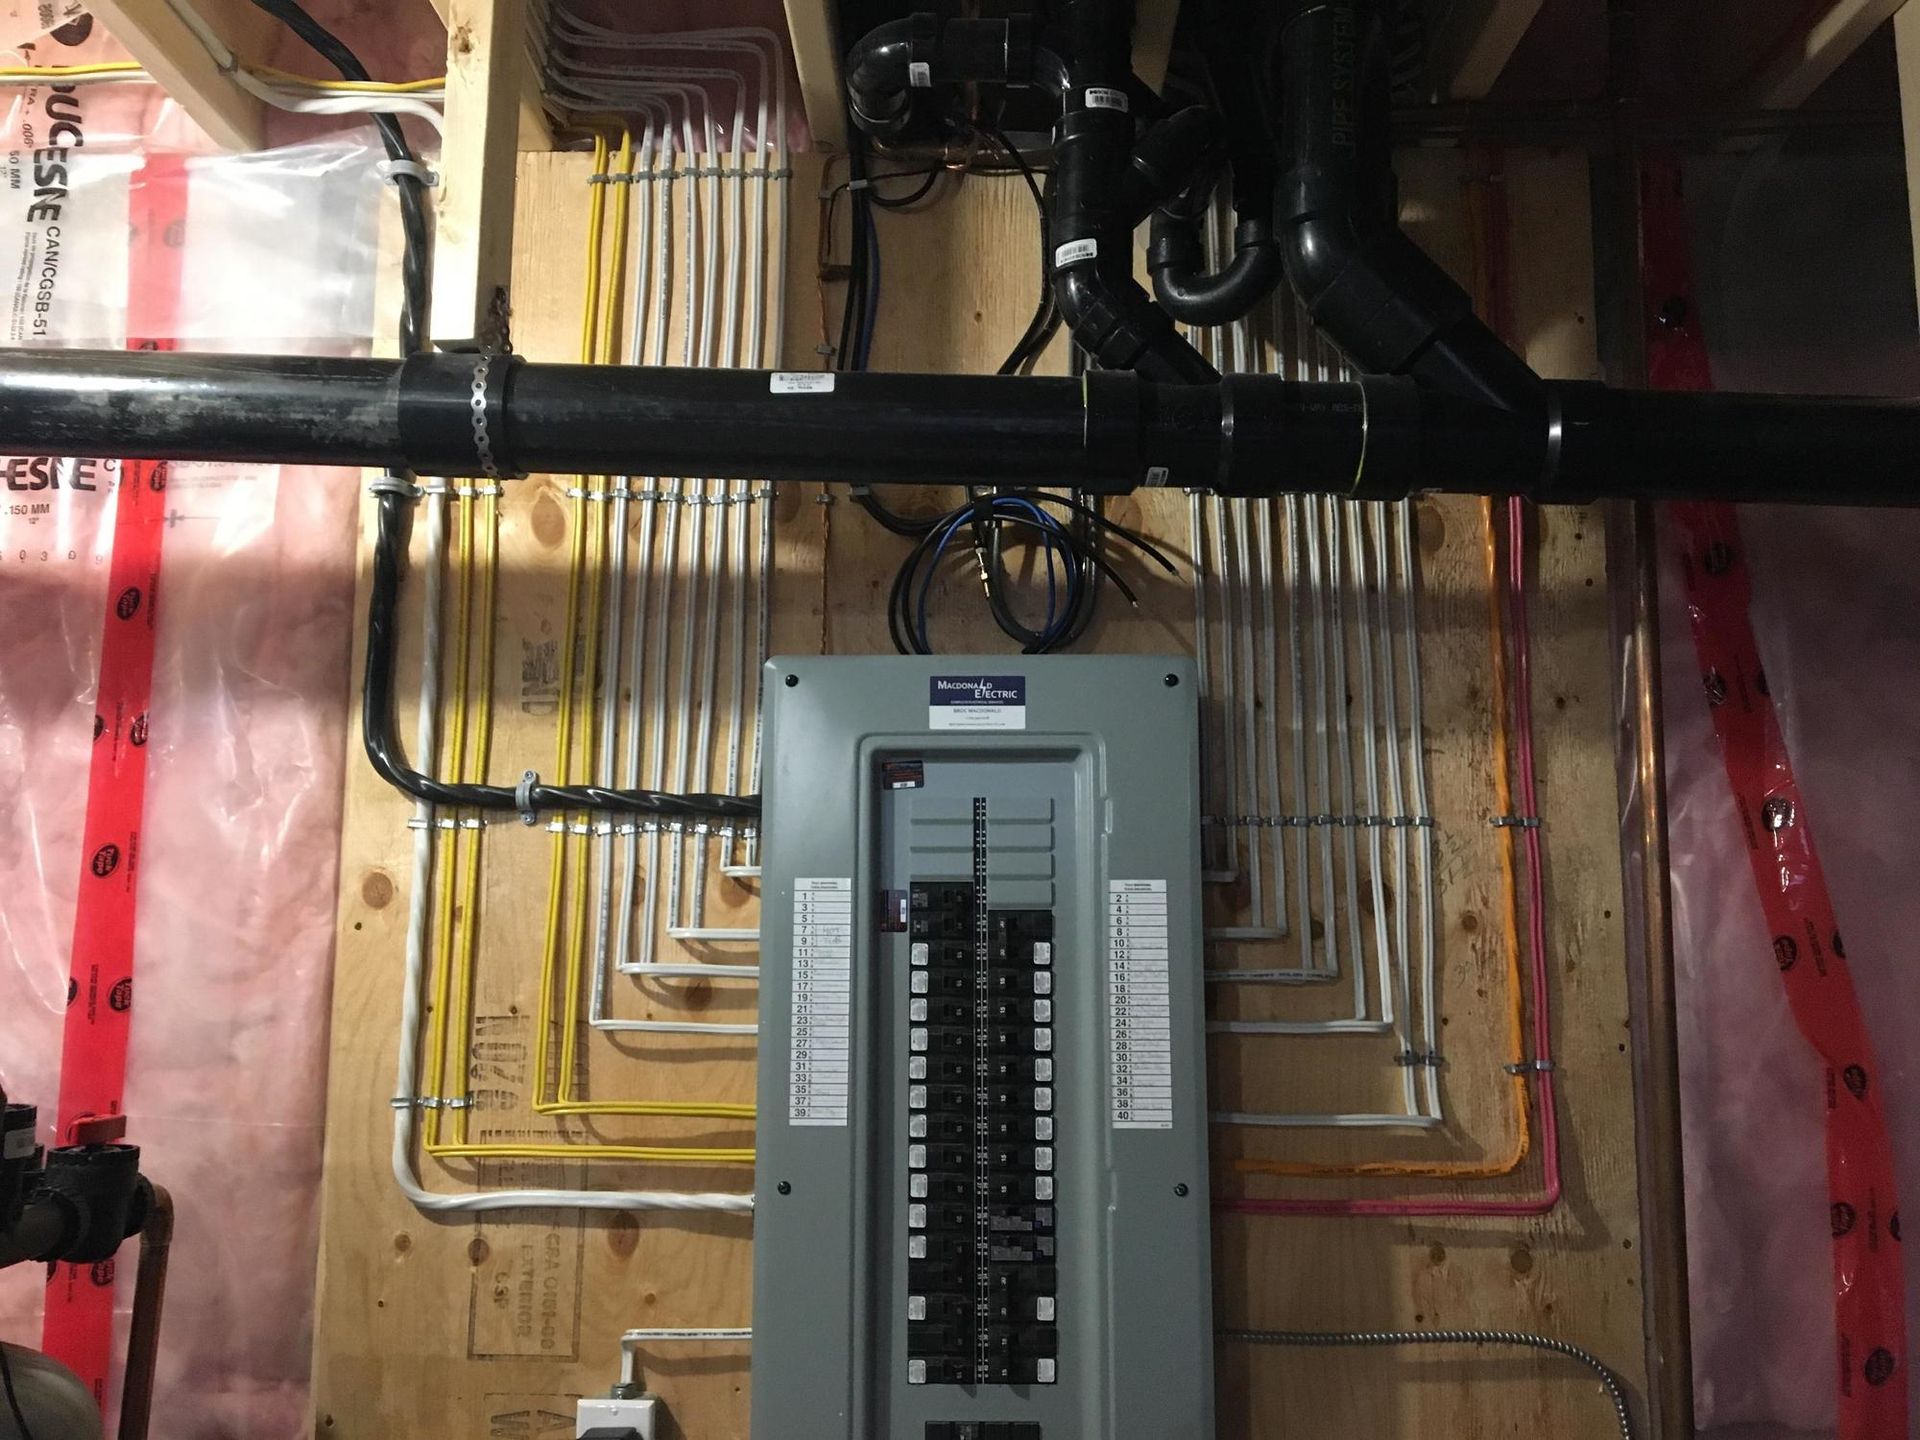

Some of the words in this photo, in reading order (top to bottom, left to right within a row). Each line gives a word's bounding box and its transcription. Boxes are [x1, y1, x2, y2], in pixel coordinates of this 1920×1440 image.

[31, 503, 50, 515] MM
[802, 892, 808, 900] 1
[1116, 894, 1122, 902] 2
[802, 904, 808, 912] 3
[1116, 906, 1122, 914] 4
[802, 914, 808, 922] 5
[1116, 916, 1122, 924] 6
[802, 926, 808, 934] 7
[1116, 928, 1122, 936] 8
[802, 936, 808, 946] 9
[1114, 938, 1124, 948] 10
[798, 948, 808, 956] 11
[1114, 950, 1124, 958] 12
[798, 960, 808, 968] 13
[1114, 962, 1124, 970] 14
[798, 970, 808, 980] 15
[1114, 972, 1126, 982] 16
[798, 982, 808, 990] 17
[1114, 984, 1126, 992] 18
[798, 994, 808, 1002] 19
[1116, 996, 1126, 1004] 20
[796, 1004, 806, 1014] 21
[1116, 1008, 1126, 1016] 22
[796, 1016, 808, 1024] 23
[1116, 1018, 1126, 1026] 24
[796, 1028, 808, 1036] 25
[1116, 1030, 1126, 1038] 26
[796, 1038, 808, 1048] 27
[1116, 1042, 1128, 1050] 28
[796, 1050, 808, 1058] 29
[1116, 1054, 1128, 1062] 30
[796, 1062, 806, 1070] 31
[1116, 1064, 1128, 1074] 32
[796, 1074, 806, 1082] 33
[1116, 1076, 1128, 1084] 34
[796, 1084, 806, 1094] 35
[1116, 1088, 1128, 1096] 36
[794, 1096, 806, 1106] 37
[1118, 1100, 1128, 1108] 38
[1118, 1112, 1128, 1120] 40
